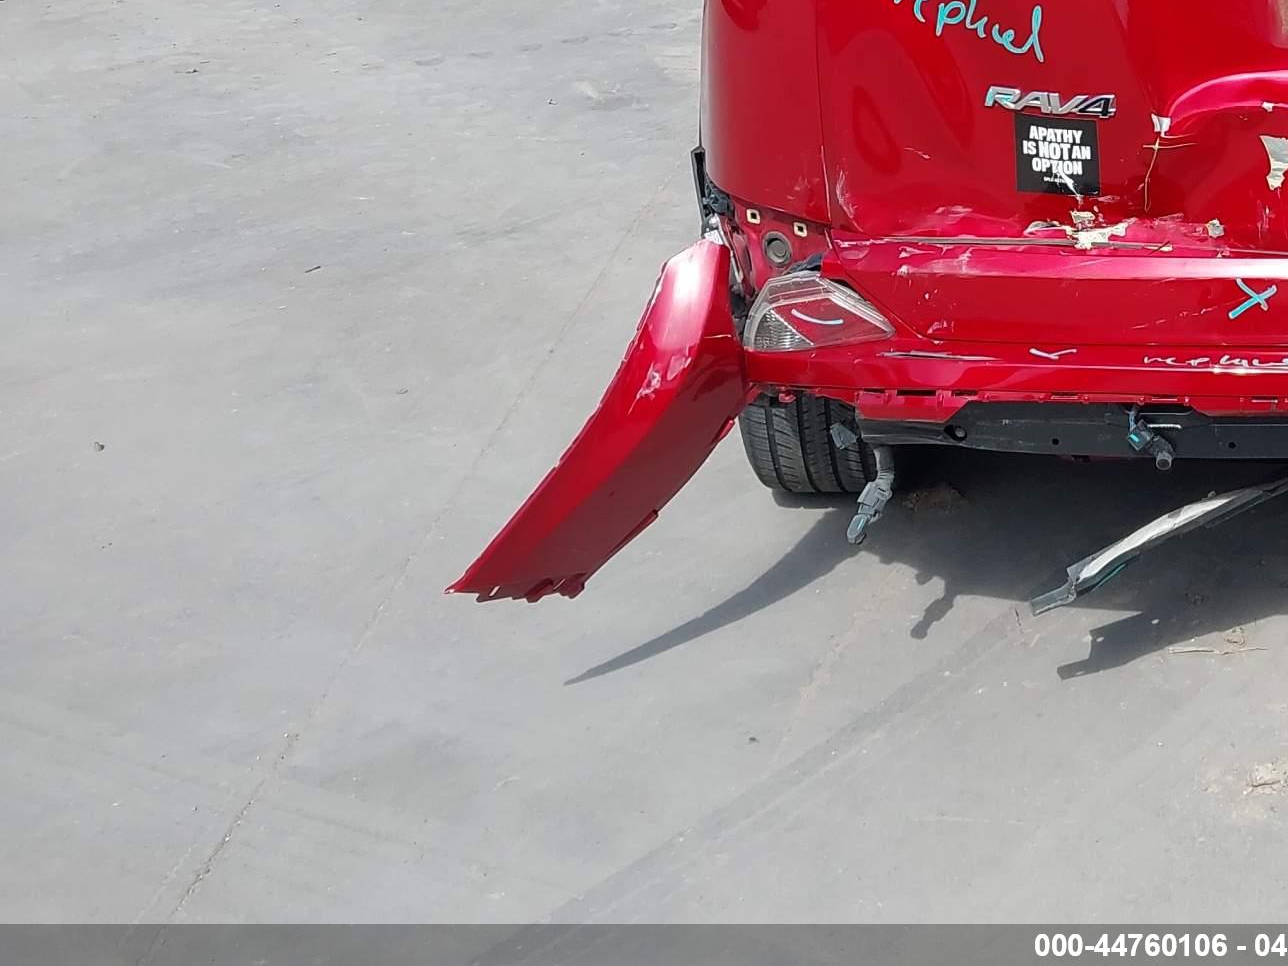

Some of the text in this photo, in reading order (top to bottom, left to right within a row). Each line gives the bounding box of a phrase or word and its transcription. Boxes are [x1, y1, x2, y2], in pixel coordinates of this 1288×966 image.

[984, 85, 1117, 119] RAV4
[1029, 125, 1082, 144] APATHY
[1022, 140, 1091, 160] IS NOT AN
[1031, 157, 1083, 175] OPTION
